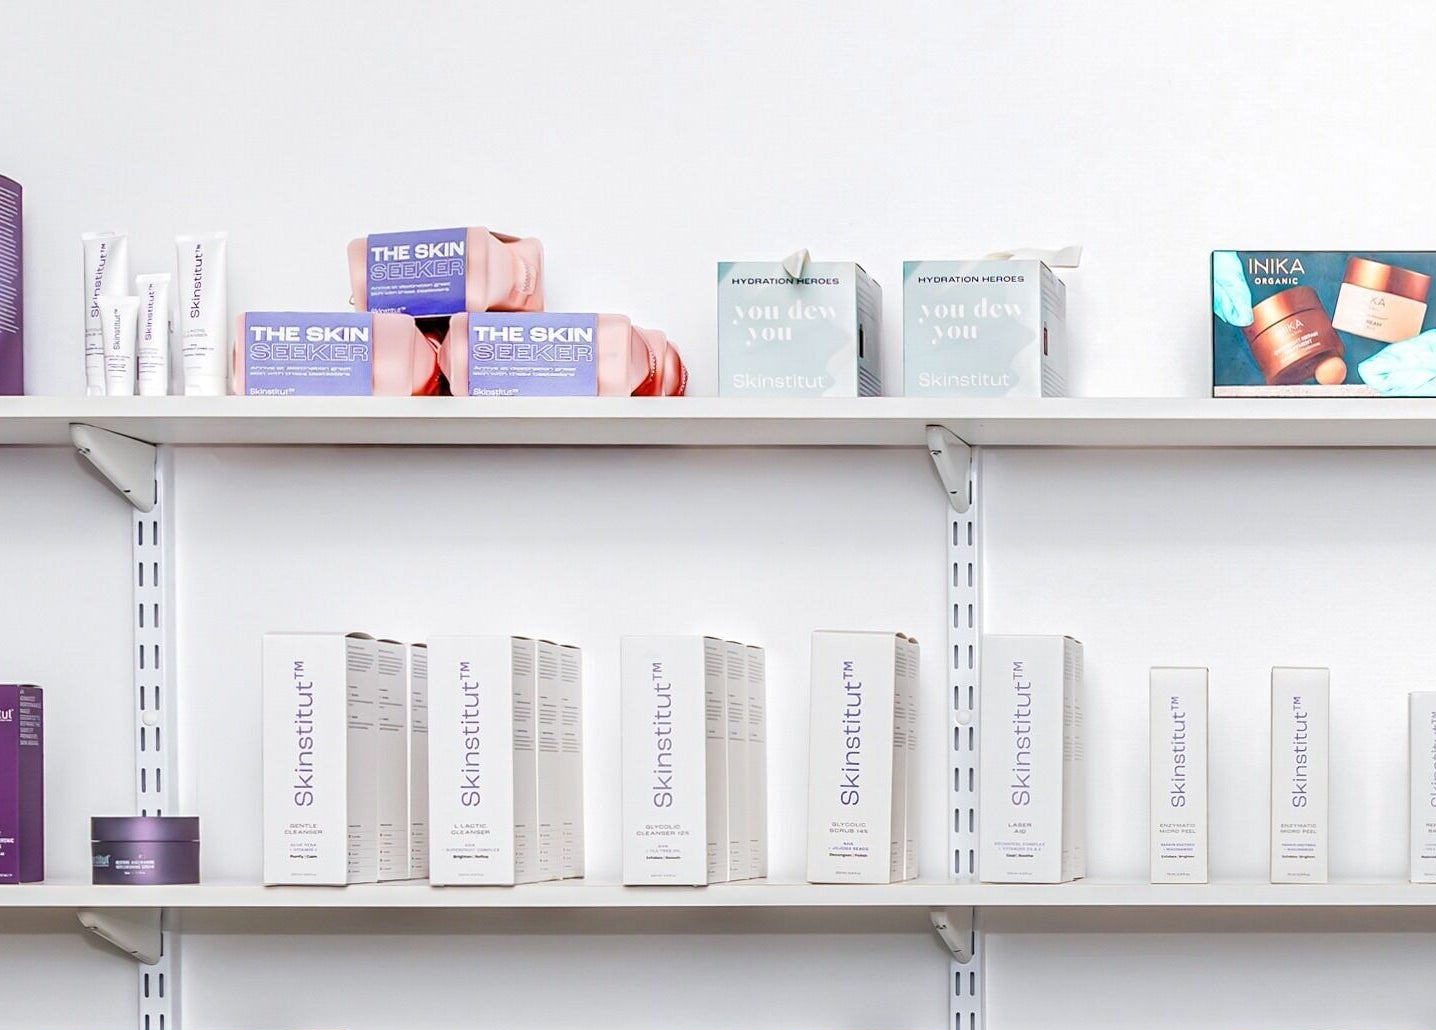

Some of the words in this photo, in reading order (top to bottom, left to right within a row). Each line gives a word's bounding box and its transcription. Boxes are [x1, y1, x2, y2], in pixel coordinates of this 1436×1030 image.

[371, 245, 411, 262] THE
[414, 240, 465, 260] SKIN
[370, 259, 464, 281] SEEKER
[1248, 258, 1305, 275] INIKA
[731, 277, 794, 285] HYDRATION
[796, 277, 840, 285] HEROES
[917, 276, 979, 284] HYDRATION
[982, 275, 1025, 283] HEROES
[1254, 277, 1299, 285] ORGANIC
[732, 303, 780, 325] you
[787, 300, 837, 321] dew
[918, 301, 965, 324] you
[973, 297, 1022, 318] dew
[250, 326, 301, 342] THE
[306, 326, 369, 342] SKIN
[472, 326, 525, 342] THE
[529, 326, 593, 342] SKIN
[746, 326, 793, 347] you
[931, 324, 979, 345] you
[250, 343, 369, 362] SEEKER
[472, 343, 593, 362] SEEKER
[293, 661, 314, 808] Skinstitut™
[460, 661, 481, 808] Skinstitut™
[652, 661, 673, 809] Skinstitut™
[840, 660, 862, 806] Skinstitut™
[1011, 660, 1032, 808] Skinstitut™
[1170, 695, 1186, 808] Skinstitut™
[1291, 695, 1308, 808] Skinstitut™
